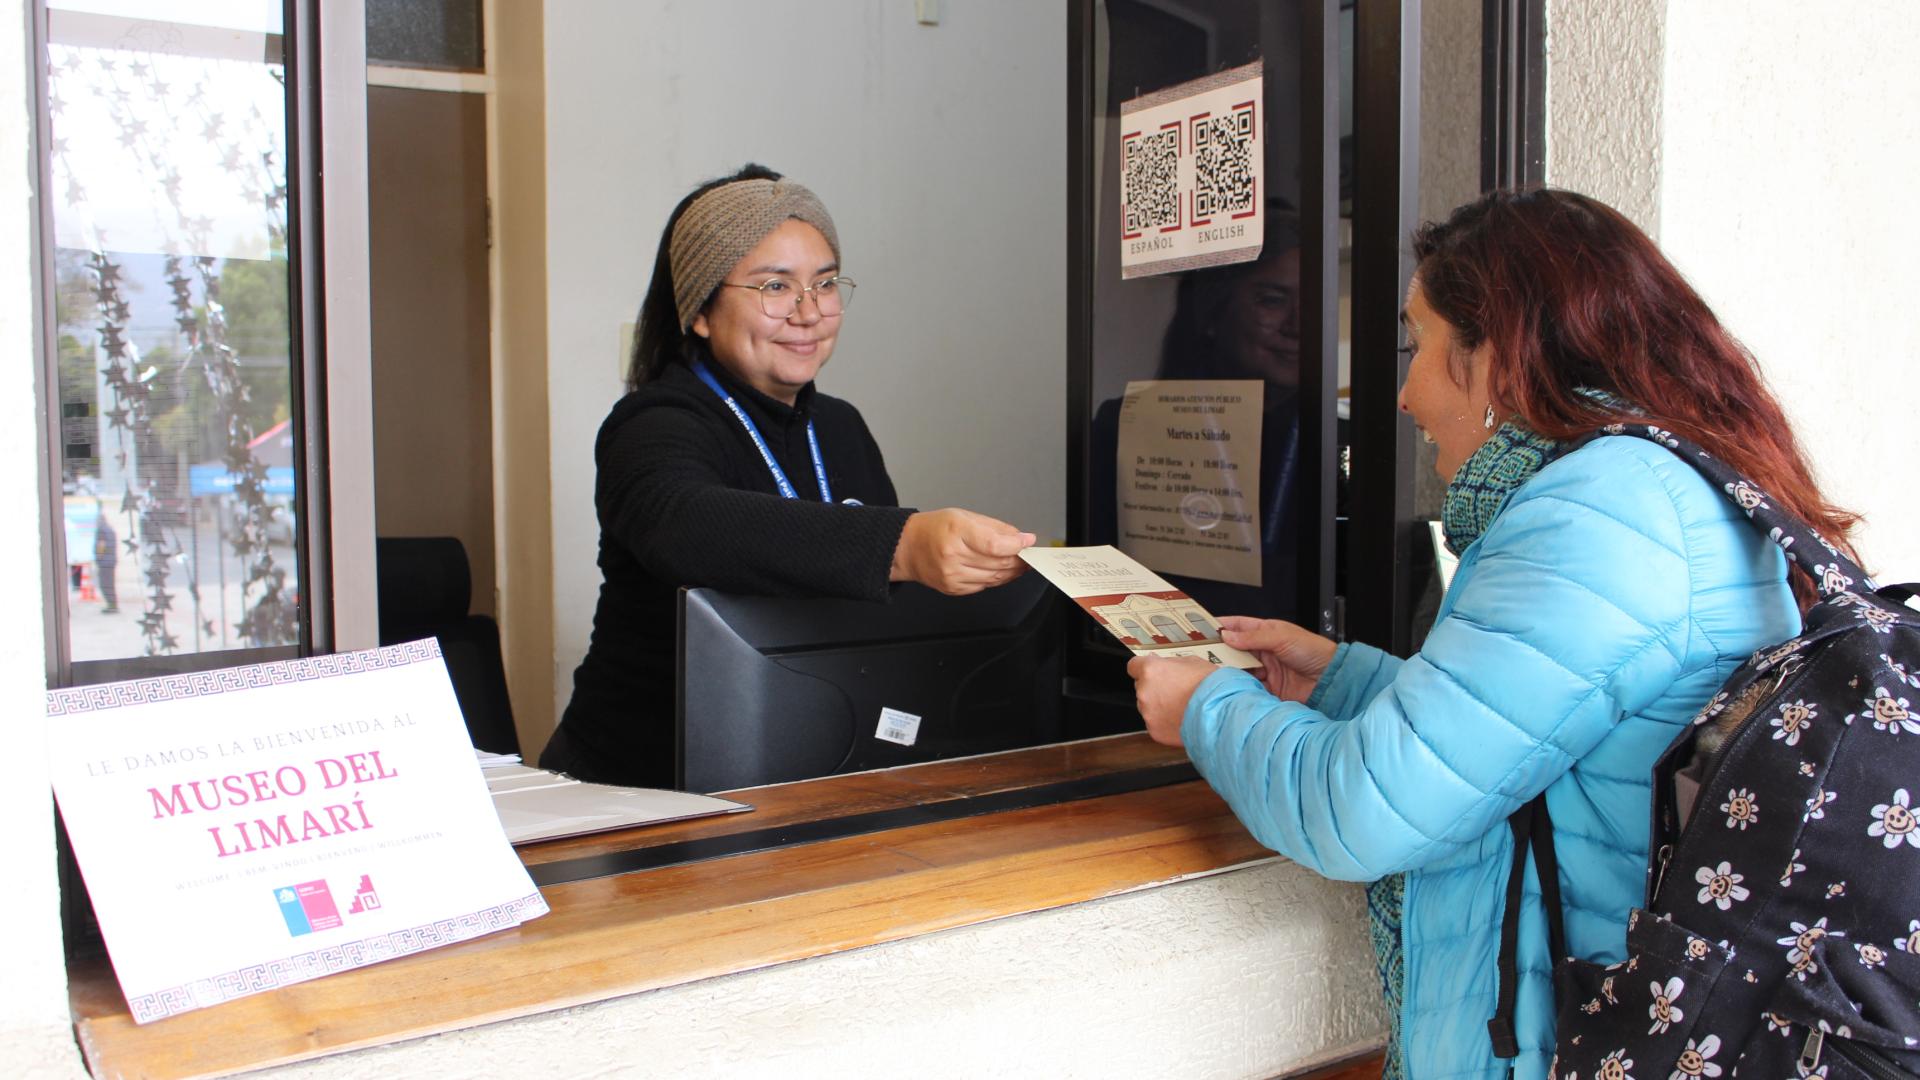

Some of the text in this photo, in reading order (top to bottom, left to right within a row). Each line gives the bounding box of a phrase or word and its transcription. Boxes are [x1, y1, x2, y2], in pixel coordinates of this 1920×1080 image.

[1131, 224, 1245, 255] ESPAÑOL ENGLISH
[725, 396, 750, 431] Servicio
[748, 430, 774, 468] Nacional
[771, 467, 783, 482] del
[1166, 427, 1231, 441] Martes a Sábado
[86, 712, 417, 777] LE DAMOS LA BIENVENIDA AL
[146, 749, 399, 820] MUSEO DEL
[207, 791, 374, 858] LIMARÍ
